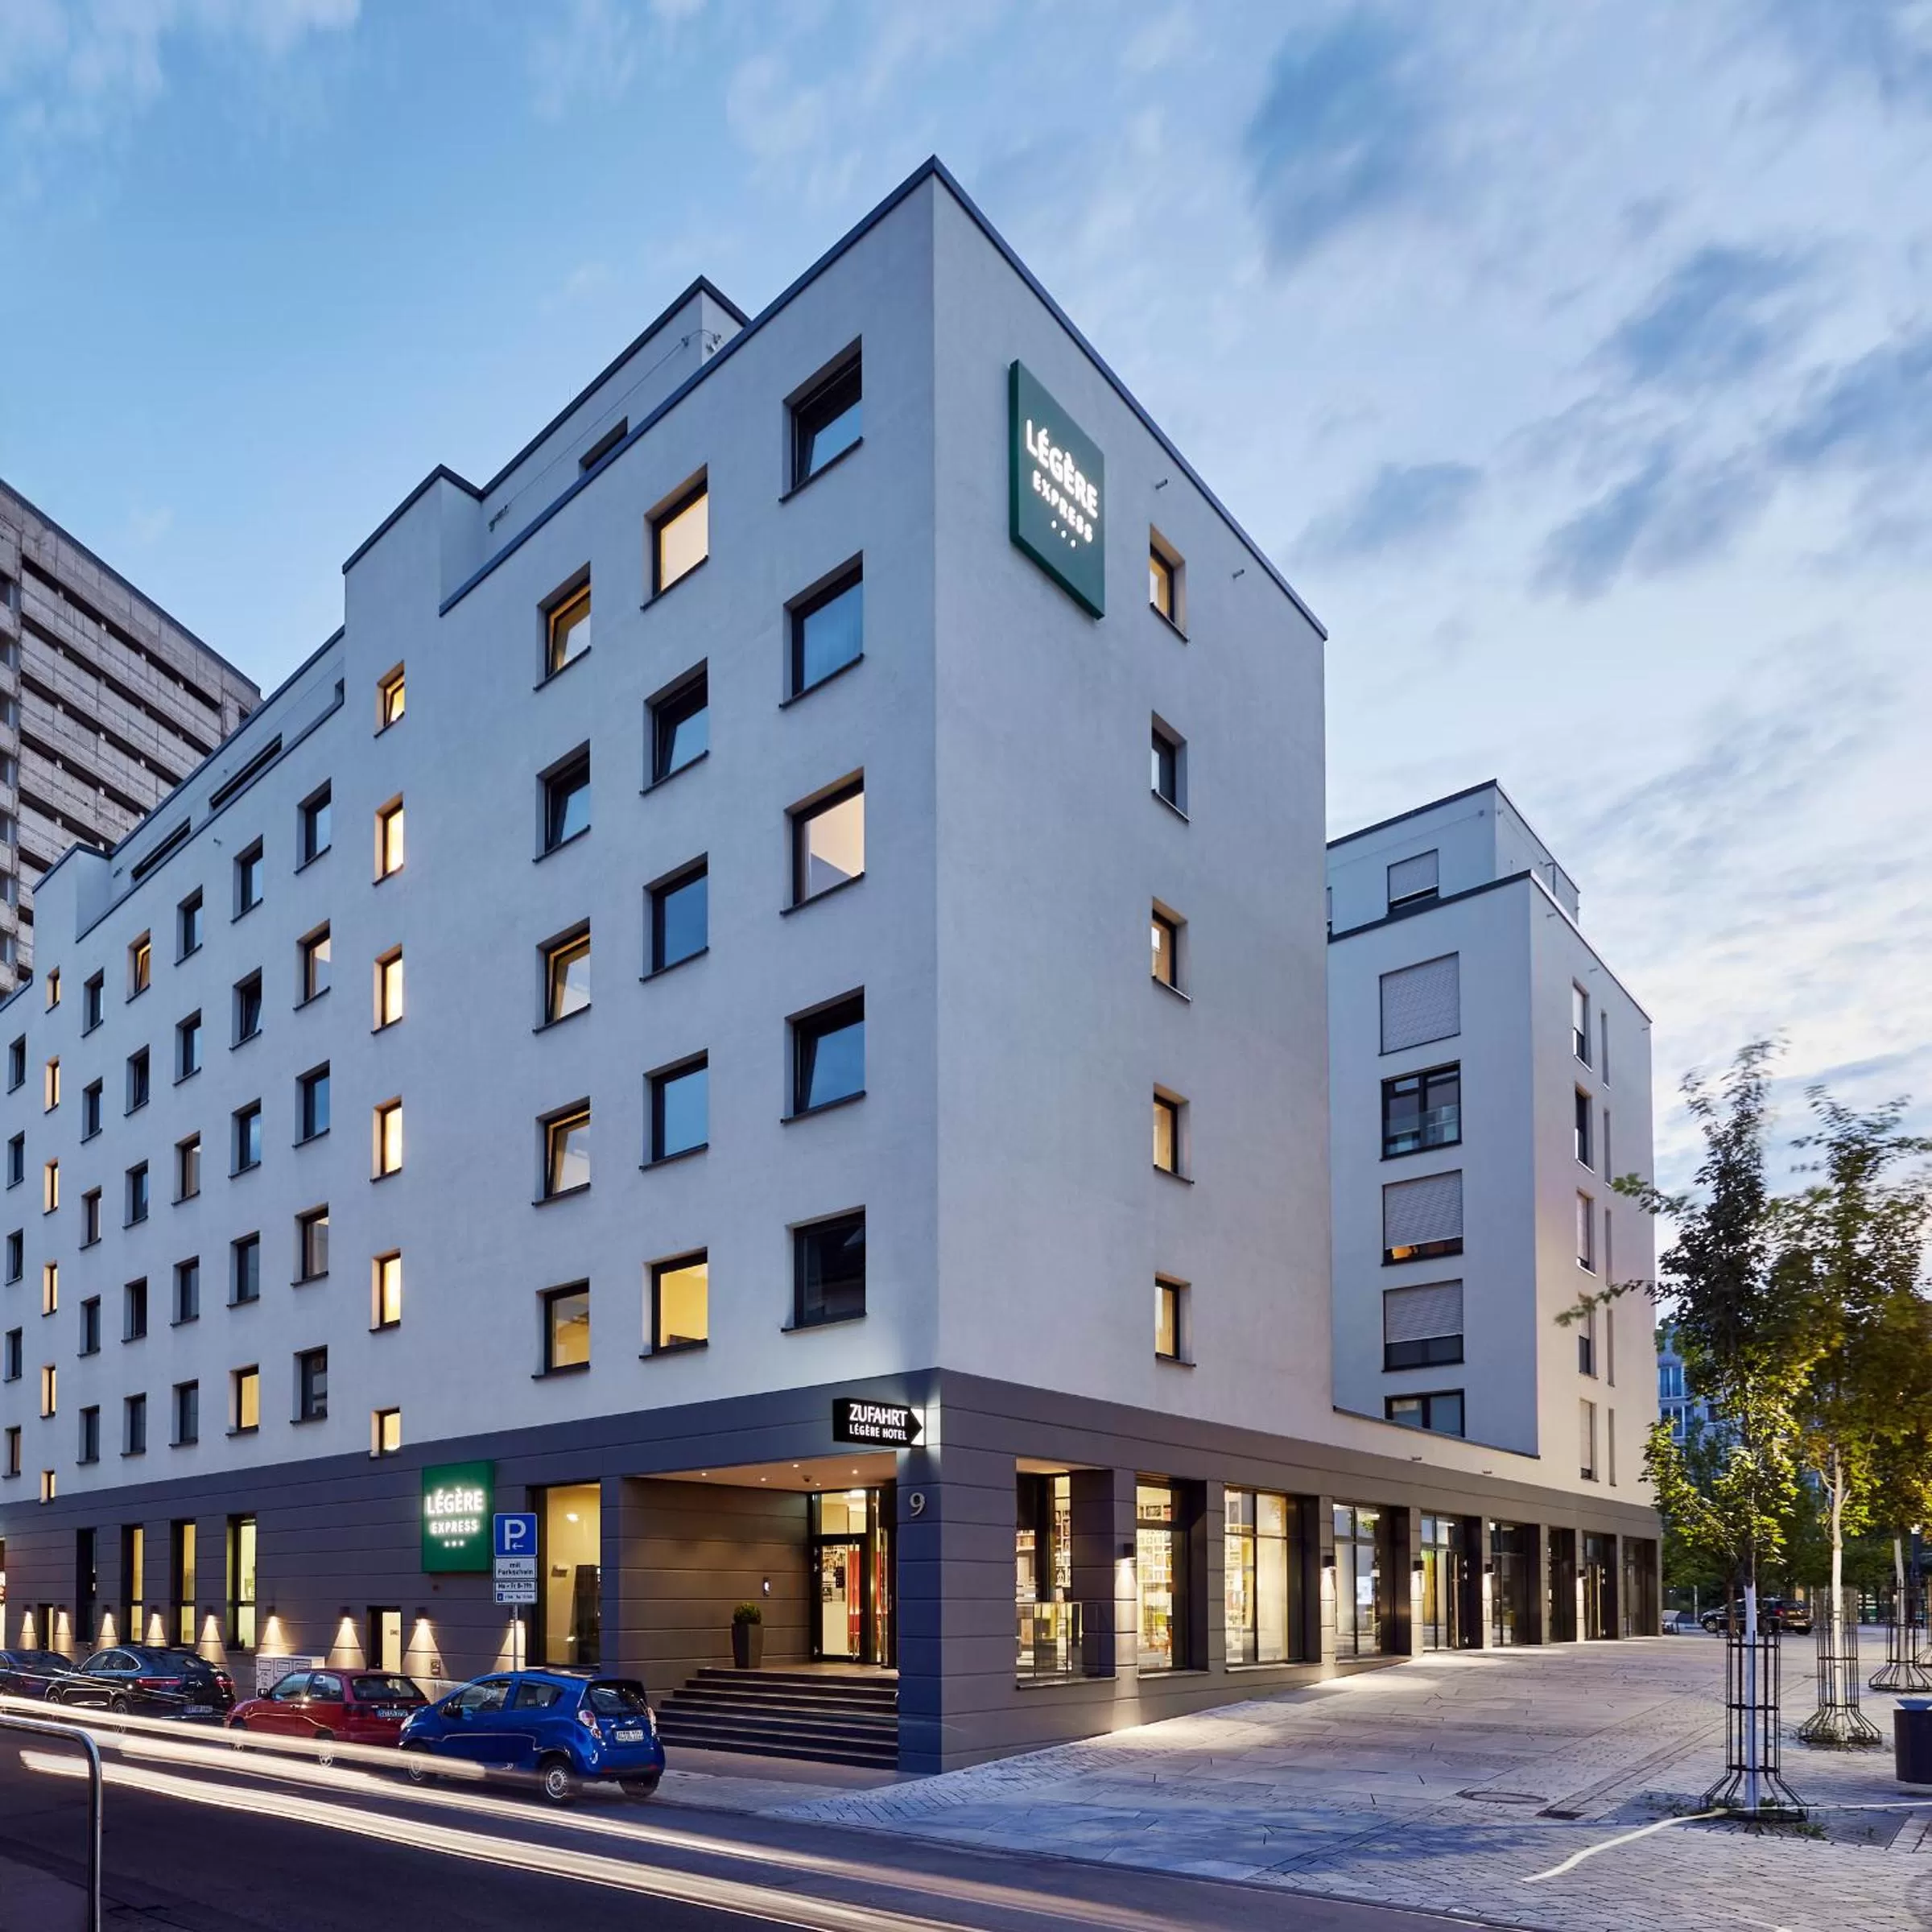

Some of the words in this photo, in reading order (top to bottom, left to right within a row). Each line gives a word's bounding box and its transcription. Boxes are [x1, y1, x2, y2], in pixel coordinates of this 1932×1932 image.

[1026, 419, 1098, 518] LÉGÈRE
[1033, 470, 1093, 543] EXPRESS
[849, 1404, 909, 1426] ZUFAHRT
[849, 1424, 880, 1438] LÉGÈRE
[882, 1428, 907, 1440] HOTEL
[427, 1486, 484, 1515] LÉGÈRE
[910, 1492, 925, 1517] 9
[431, 1518, 479, 1534] EXPRESS
[504, 1519, 526, 1550] P
